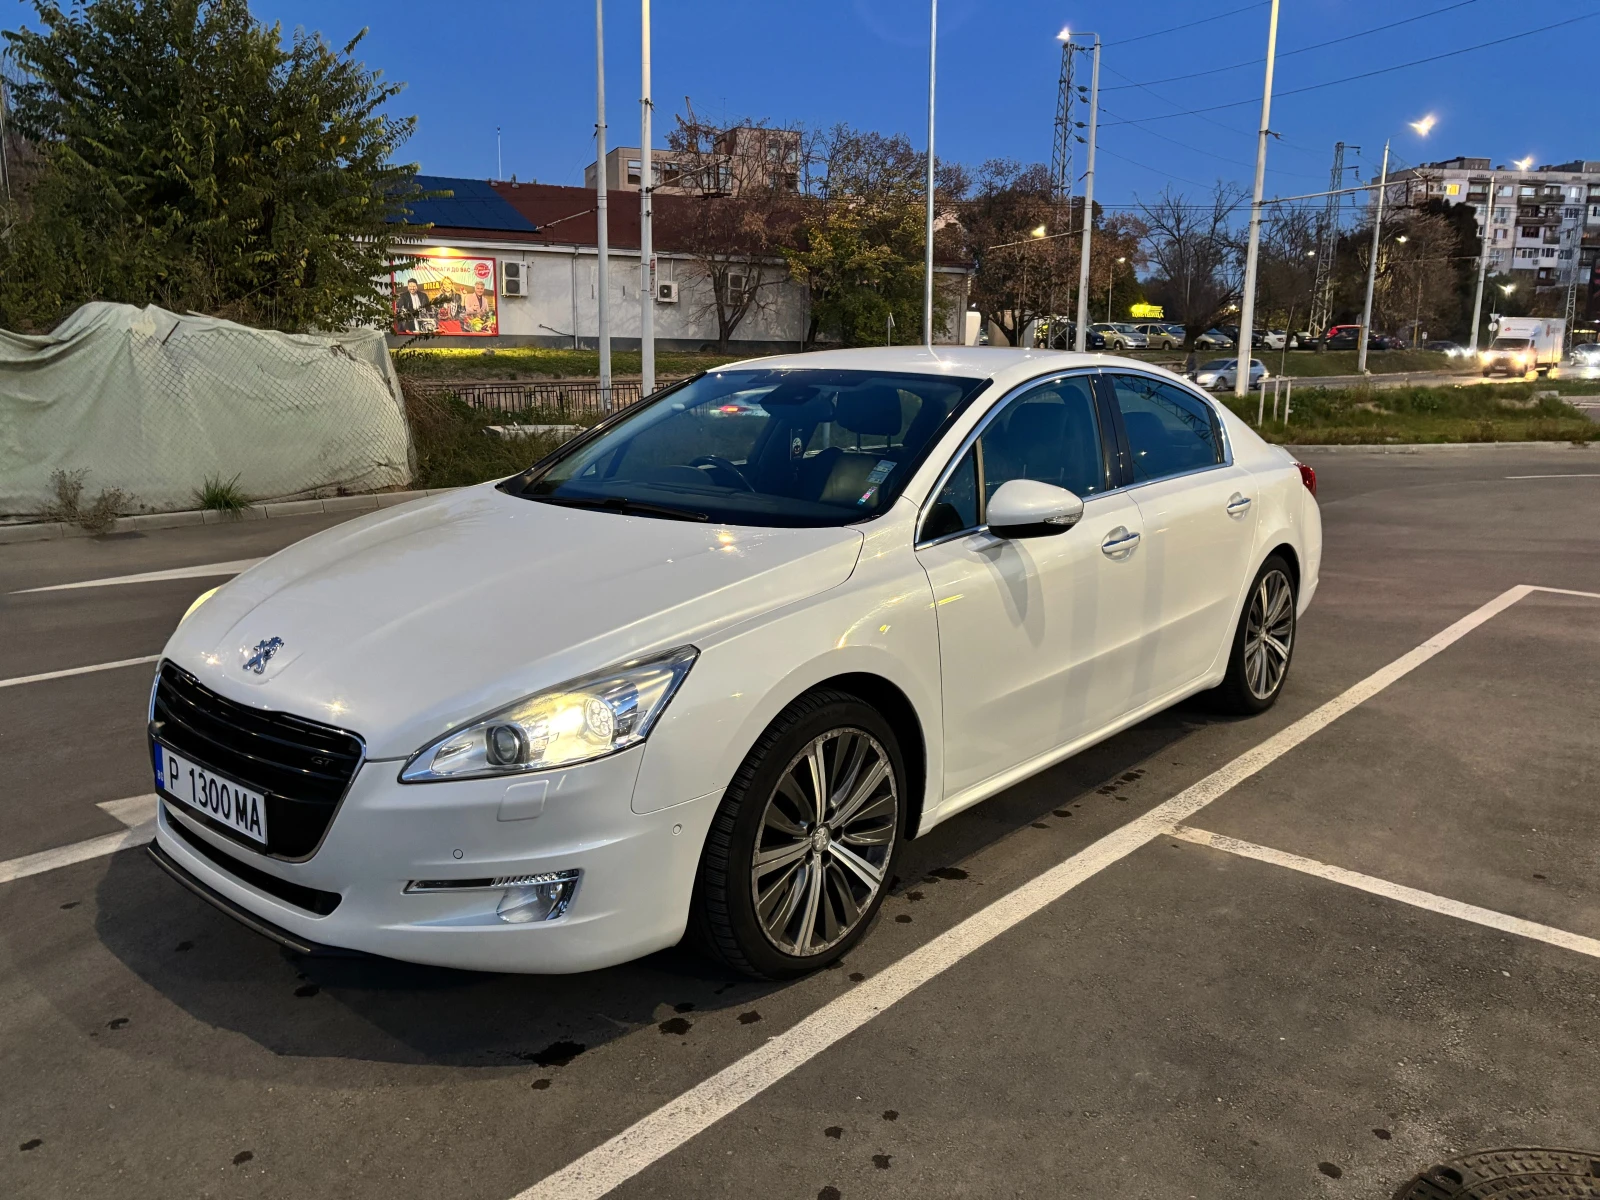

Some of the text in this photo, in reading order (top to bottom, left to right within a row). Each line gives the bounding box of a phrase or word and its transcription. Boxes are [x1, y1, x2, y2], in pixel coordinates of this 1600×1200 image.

[169, 755, 262, 837] P 1300 MA
